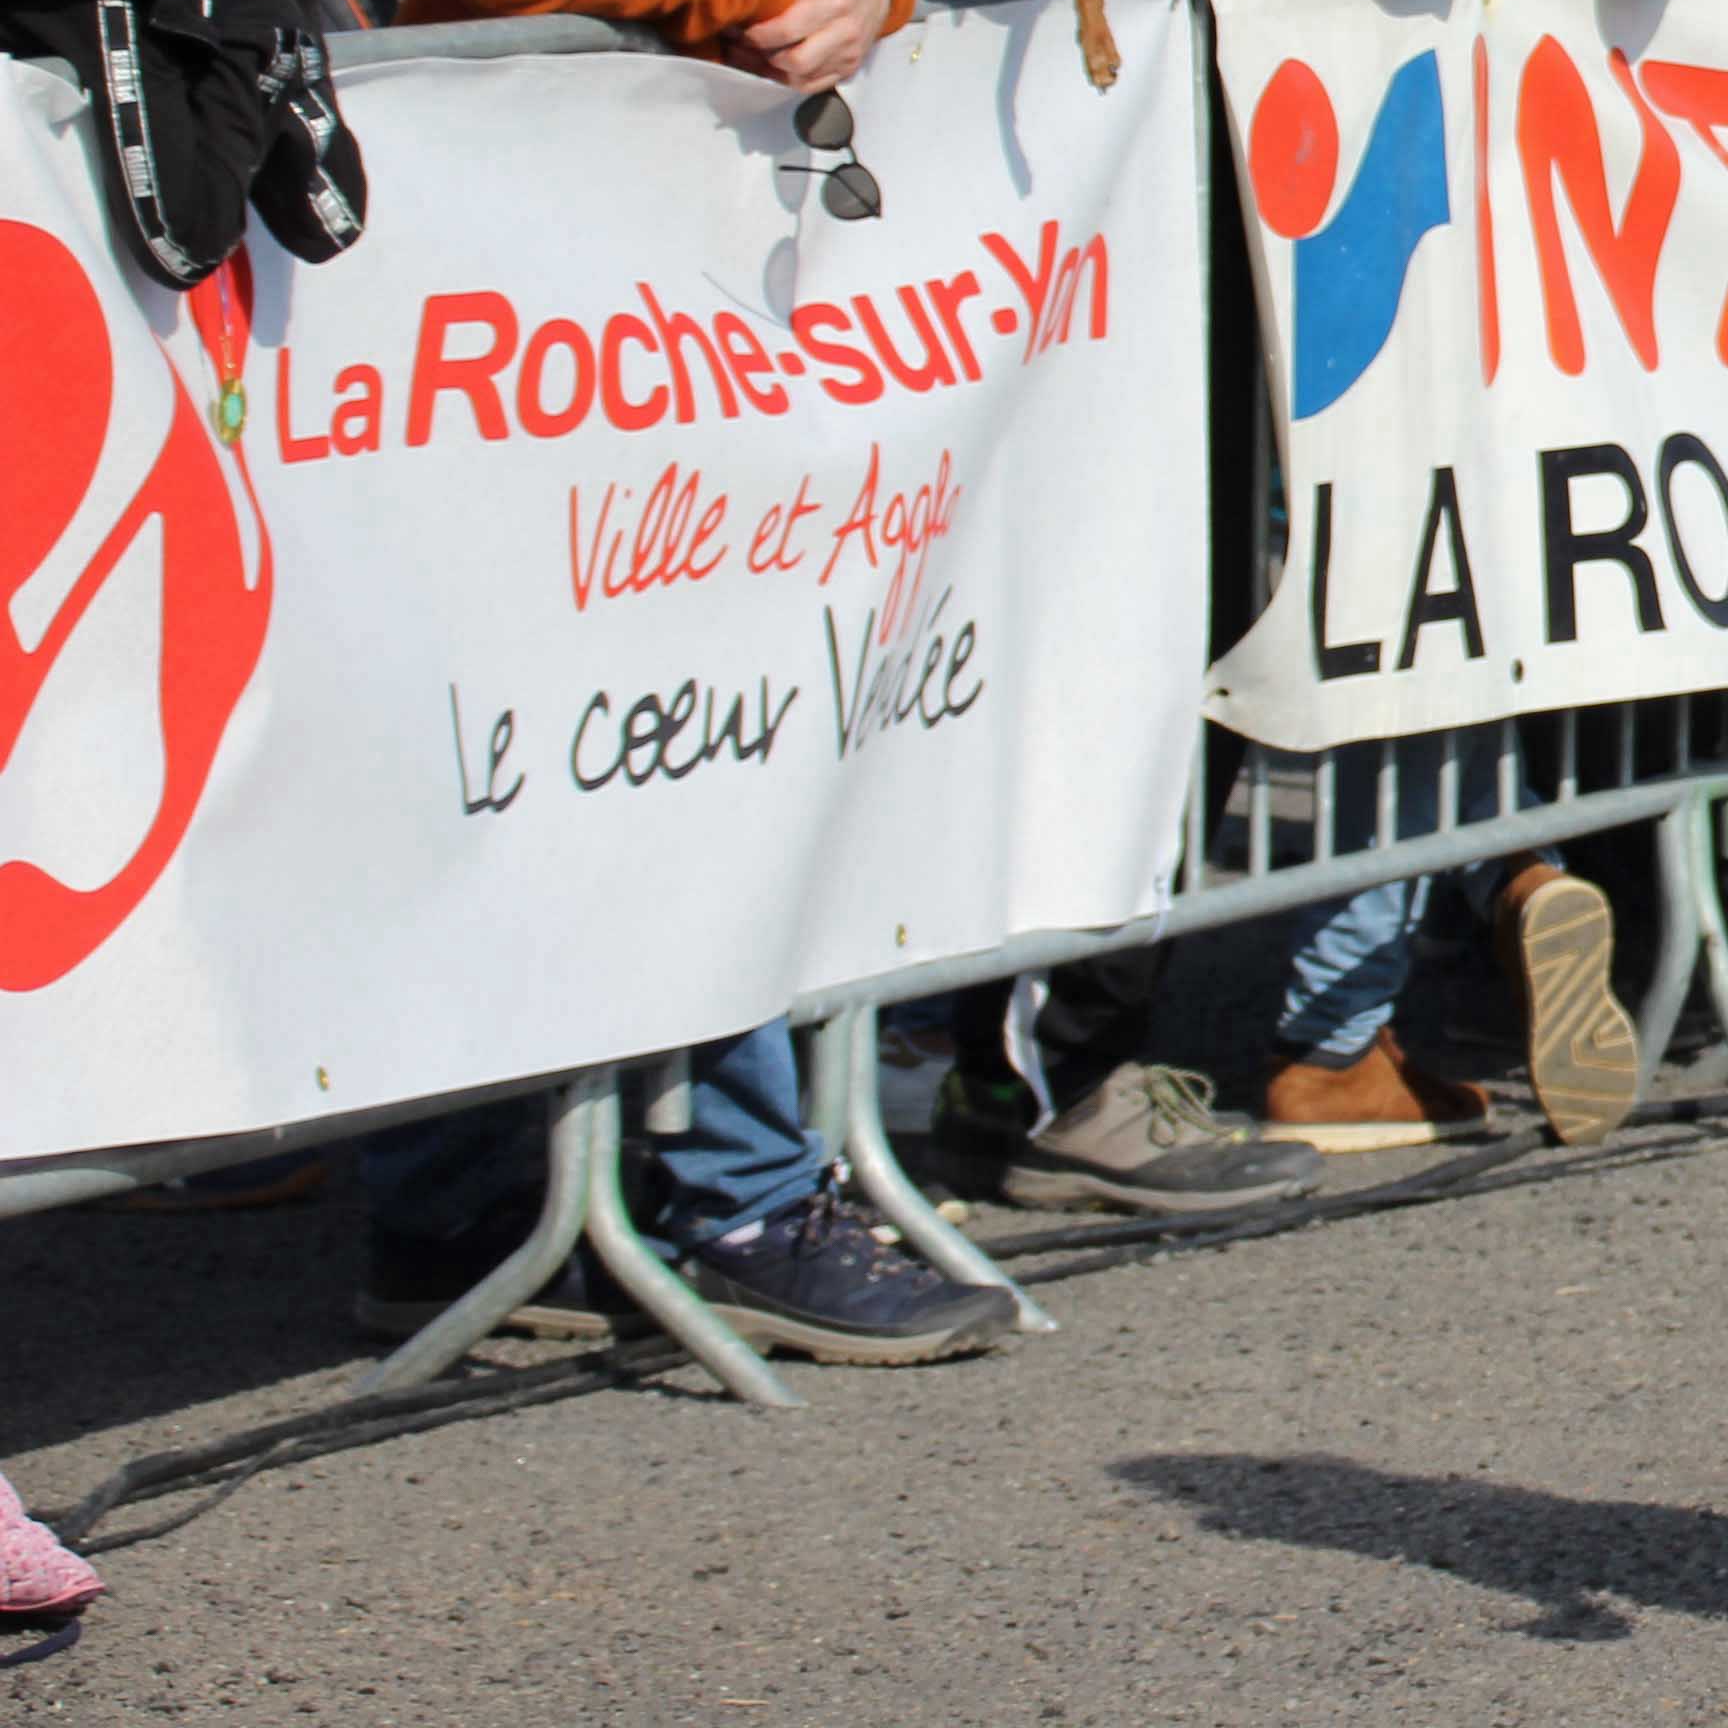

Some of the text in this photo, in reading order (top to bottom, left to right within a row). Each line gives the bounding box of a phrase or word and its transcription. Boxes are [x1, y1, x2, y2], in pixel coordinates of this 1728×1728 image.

[276, 219, 1108, 464] La Roche-sur-Yn
[568, 461, 731, 613] Ville
[748, 472, 822, 575] et
[1309, 466, 1484, 681] LA
[448, 679, 527, 816] Le
